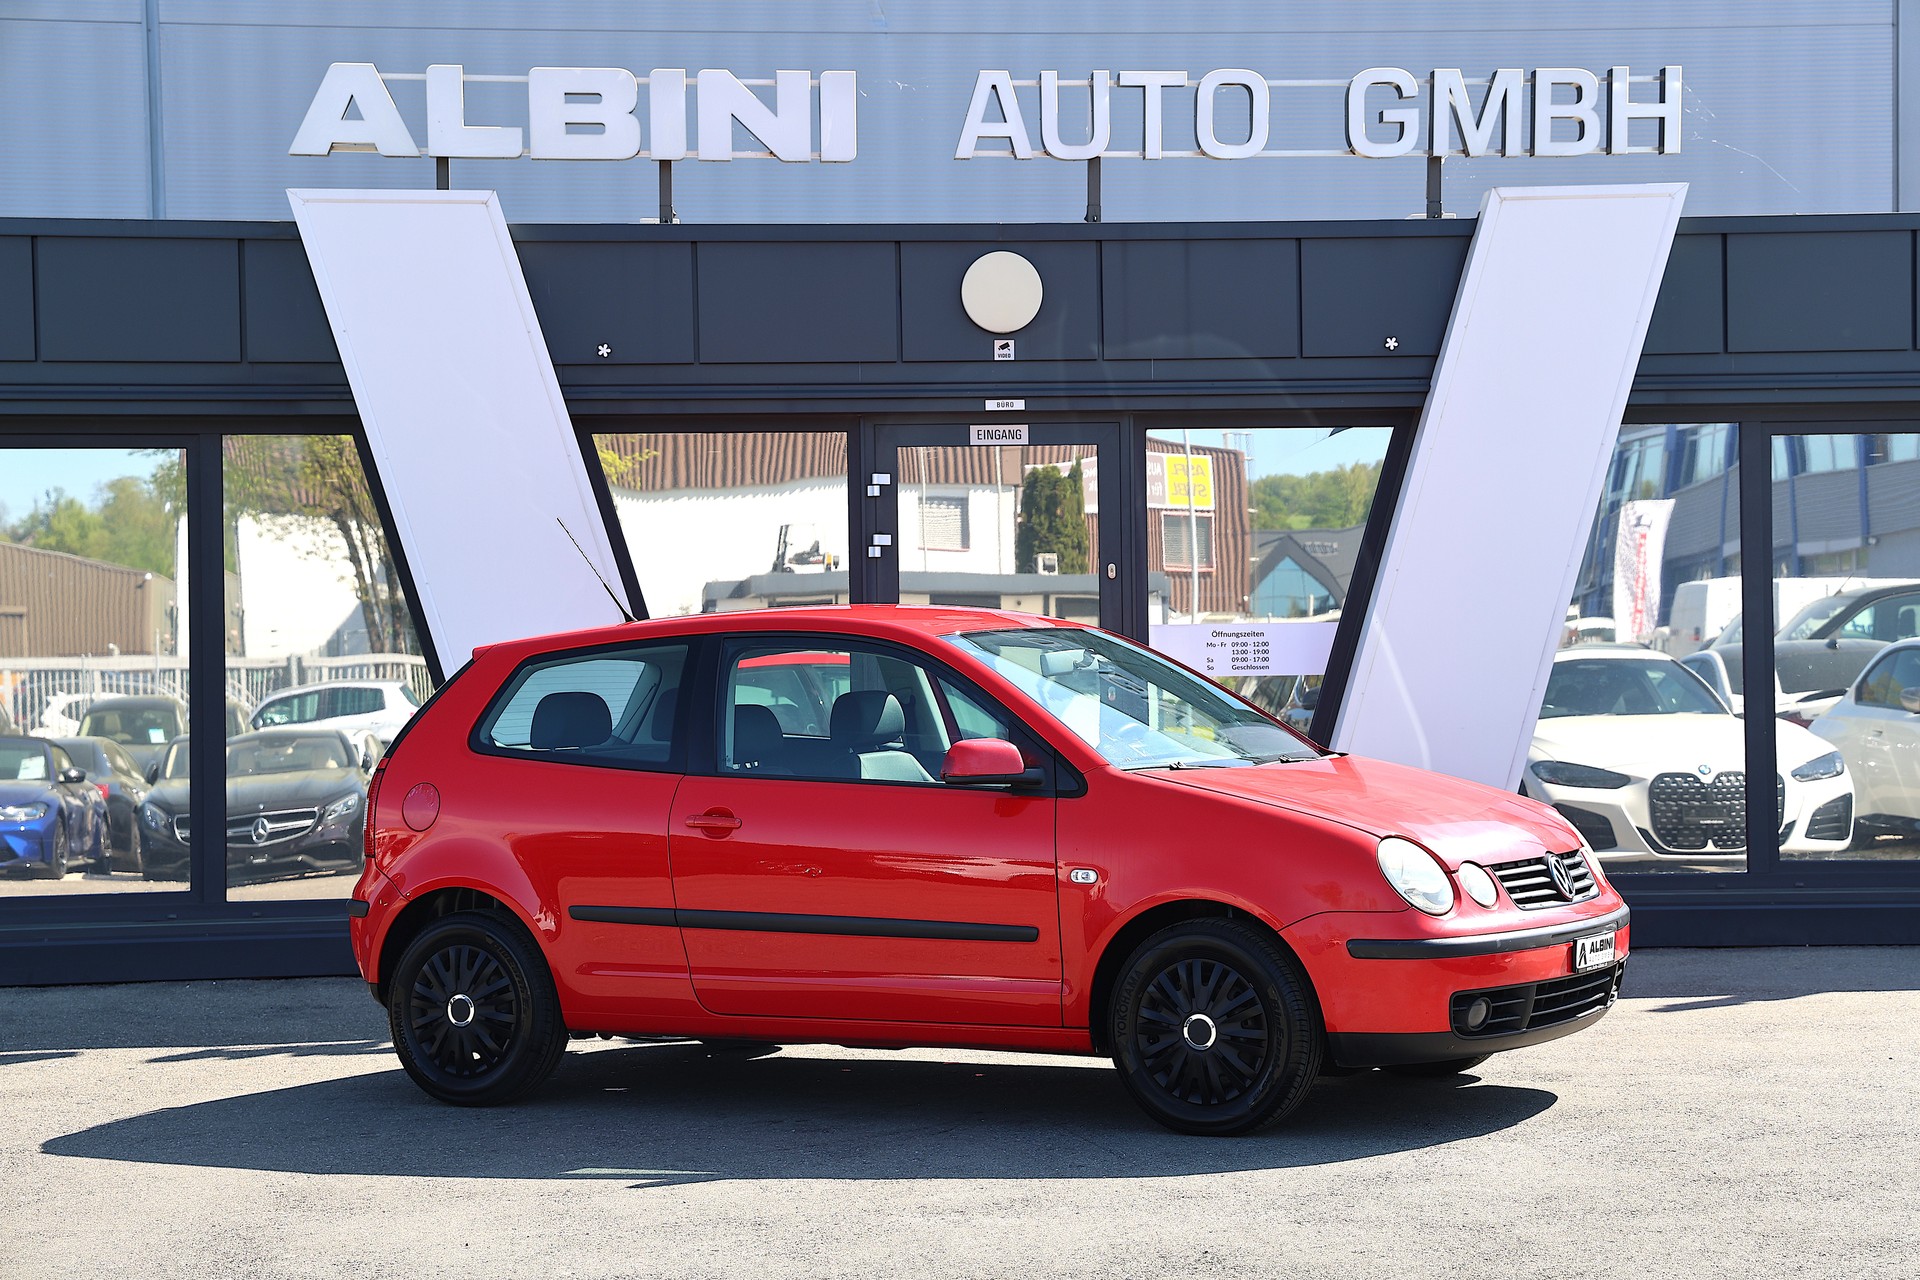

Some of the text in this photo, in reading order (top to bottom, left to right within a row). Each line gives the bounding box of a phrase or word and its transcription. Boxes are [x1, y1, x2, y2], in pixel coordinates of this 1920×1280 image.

[288, 62, 1683, 163] ALBINI AUTO GMBH
[977, 429, 1022, 440] EINGANG
[1211, 630, 1265, 638] Öffnungszeiten
[1117, 970, 1144, 1038] YOKOHAMA
